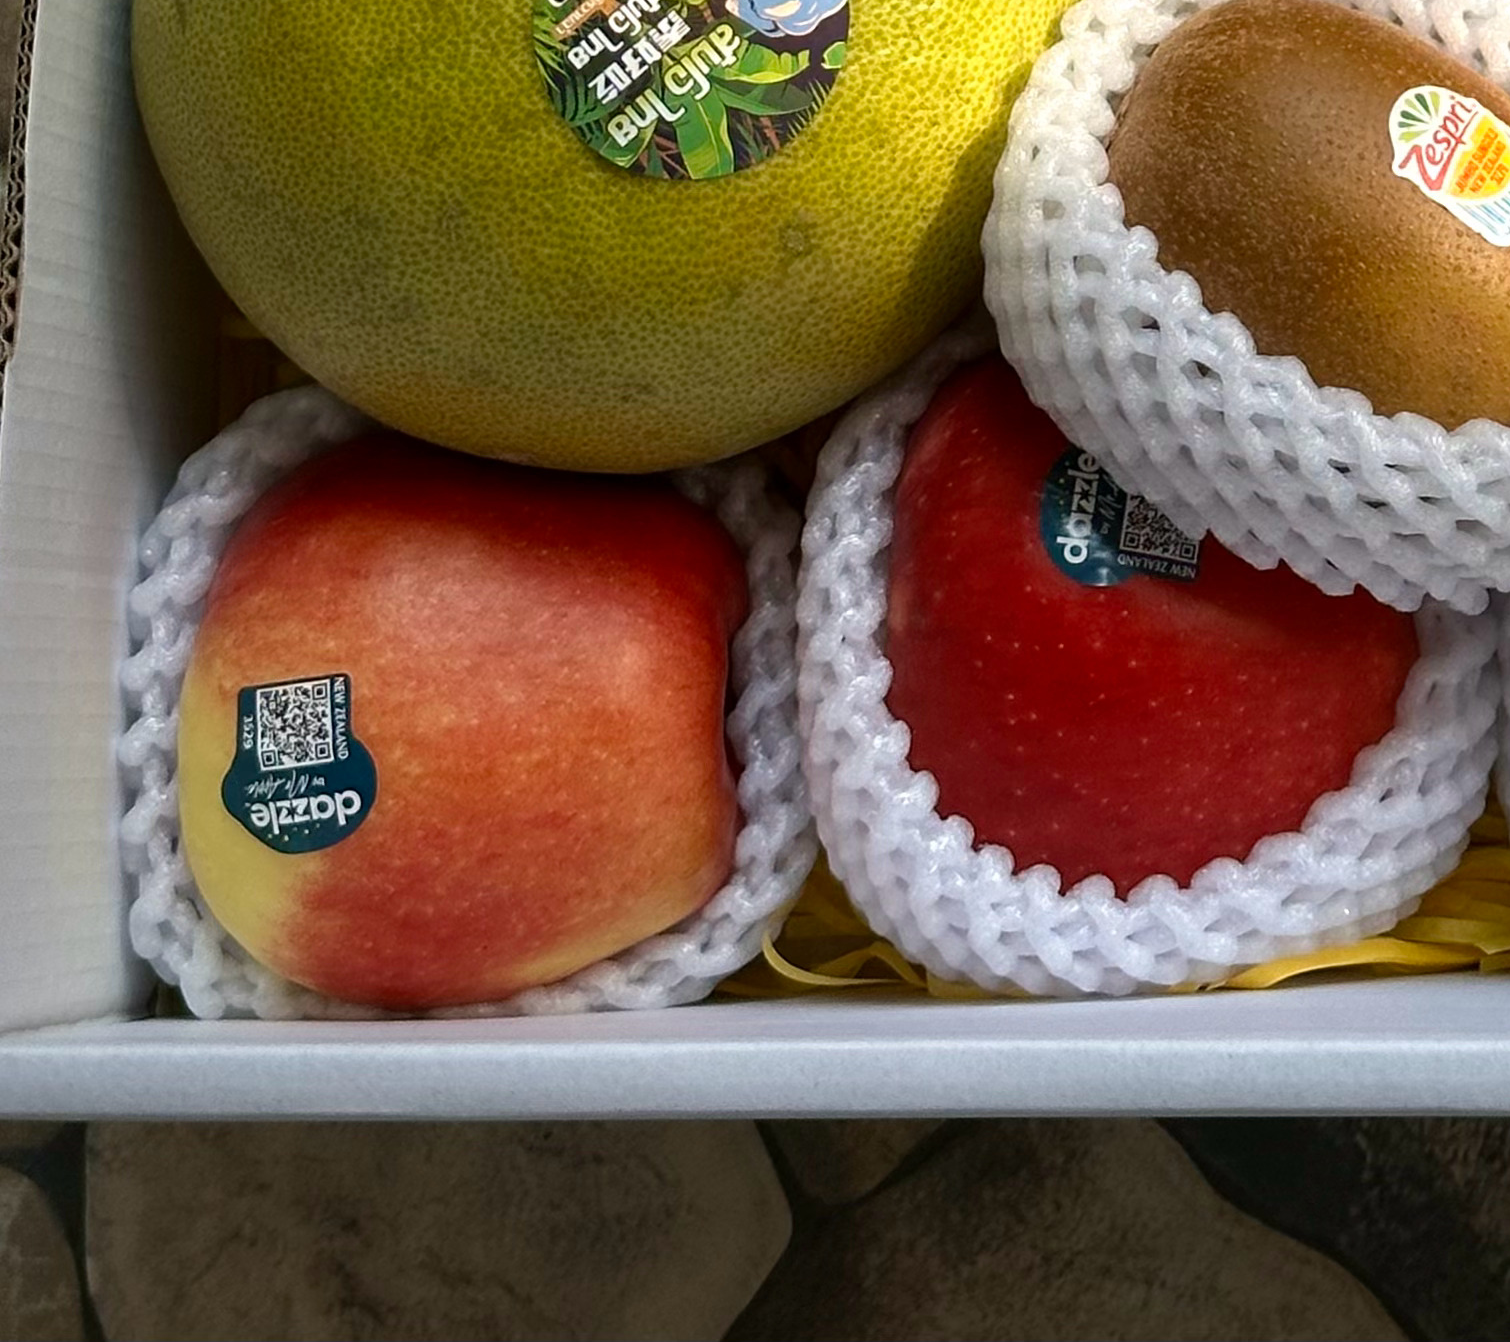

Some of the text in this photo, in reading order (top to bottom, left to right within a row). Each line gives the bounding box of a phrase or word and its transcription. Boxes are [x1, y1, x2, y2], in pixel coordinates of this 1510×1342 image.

[587, 10, 692, 105] 泰好吃
[1398, 95, 1478, 191] Zespri
[1056, 453, 1101, 564] dazzle
[1117, 553, 1197, 579] NEW ZEALAND
[333, 676, 349, 760] NEW ZEALAND
[250, 790, 362, 835] dazzle
